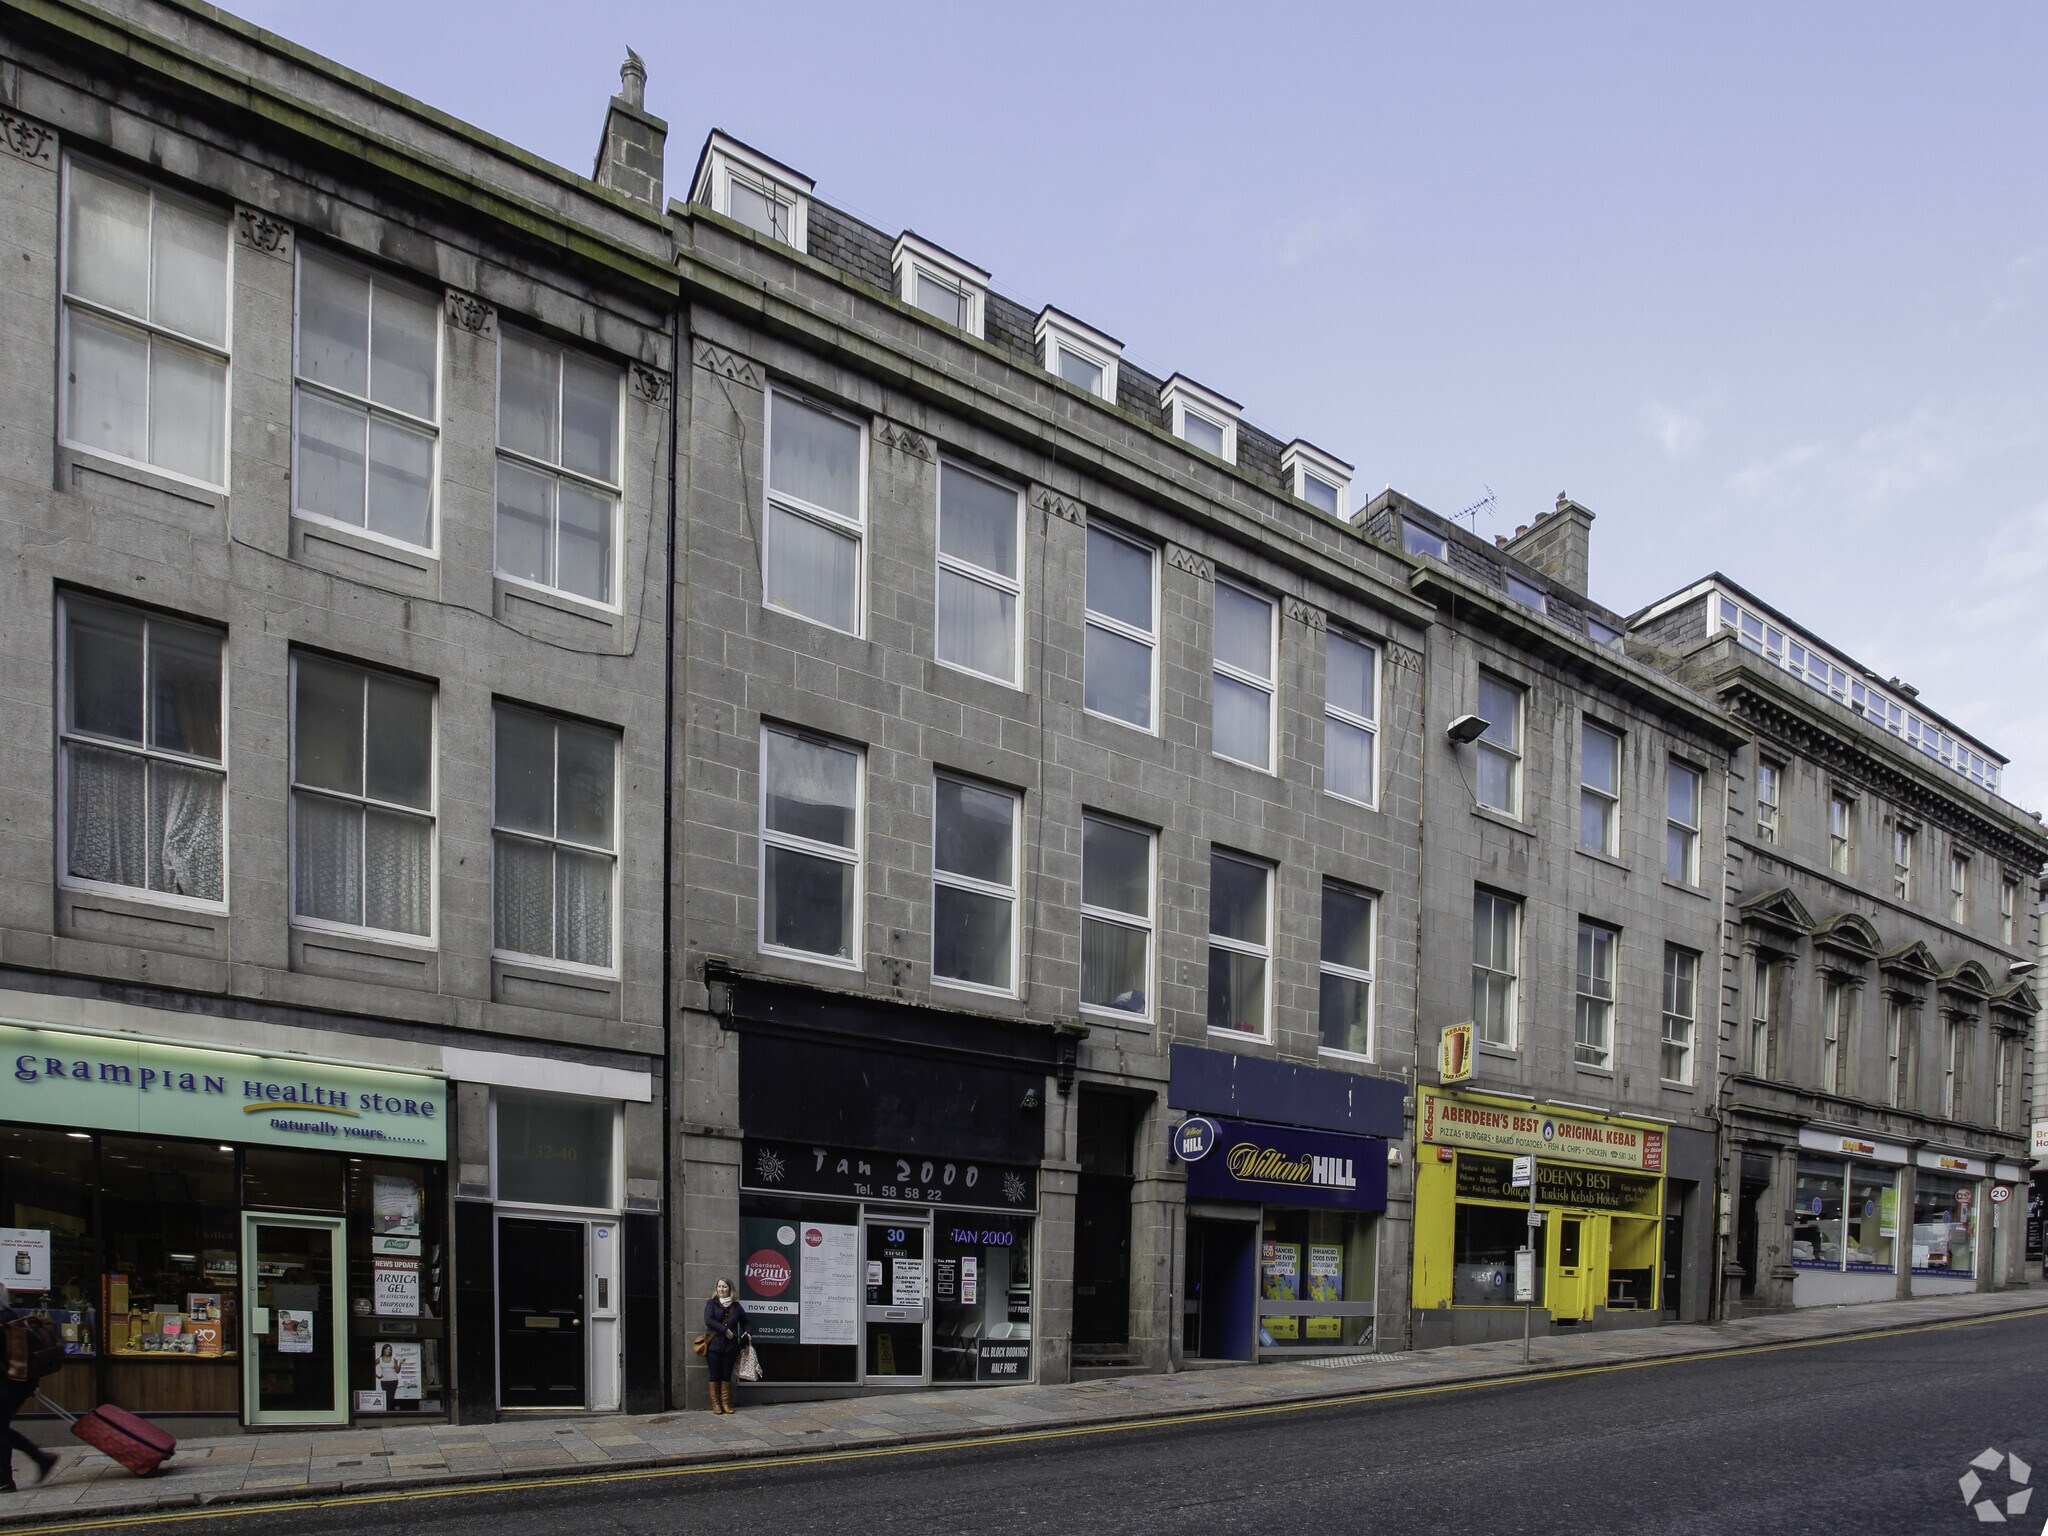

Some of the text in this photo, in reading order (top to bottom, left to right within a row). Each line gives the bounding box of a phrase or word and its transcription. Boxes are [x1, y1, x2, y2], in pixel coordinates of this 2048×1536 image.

[1444, 1026, 1471, 1038] KEBABS
[270, 1118, 338, 1138] naturally
[1442, 1105, 1636, 1148] ABERDEEN'S BEST ORIGINAL KEBAB
[1183, 1137, 1203, 1153] HILL
[1440, 1127, 1461, 1139] PIZZAS
[1465, 1130, 1491, 1144] BURGERS
[1495, 1135, 1514, 1147] BAKED
[1516, 1137, 1543, 1151] POTATOES
[1548, 1142, 1559, 1151] FISH
[1561, 1144, 1565, 1152] &
[1567, 1145, 1581, 1154] CHIPS
[1586, 1147, 1607, 1158] CHICKEN
[812, 1148, 979, 1188] Tan 2000
[1227, 1143, 1356, 1187] William HILL
[1536, 1167, 1612, 1190] RDEEN'S BEST
[854, 1182, 942, 1201] Tel. 58 58 22
[1992, 1190, 2007, 1198] 20
[887, 1229, 905, 1242] 30
[953, 1228, 1014, 1246] TAN 2000
[375, 1260, 418, 1269] NEWS UPDATE
[745, 1264, 792, 1281] beauty
[376, 1273, 417, 1284] ARNICA
[387, 1284, 406, 1293] GEL
[768, 1304, 789, 1312] open
[981, 1347, 990, 1358] ALL
[990, 1347, 1005, 1358] BLOCK
[991, 1363, 1018, 1373] HALF PRICE
